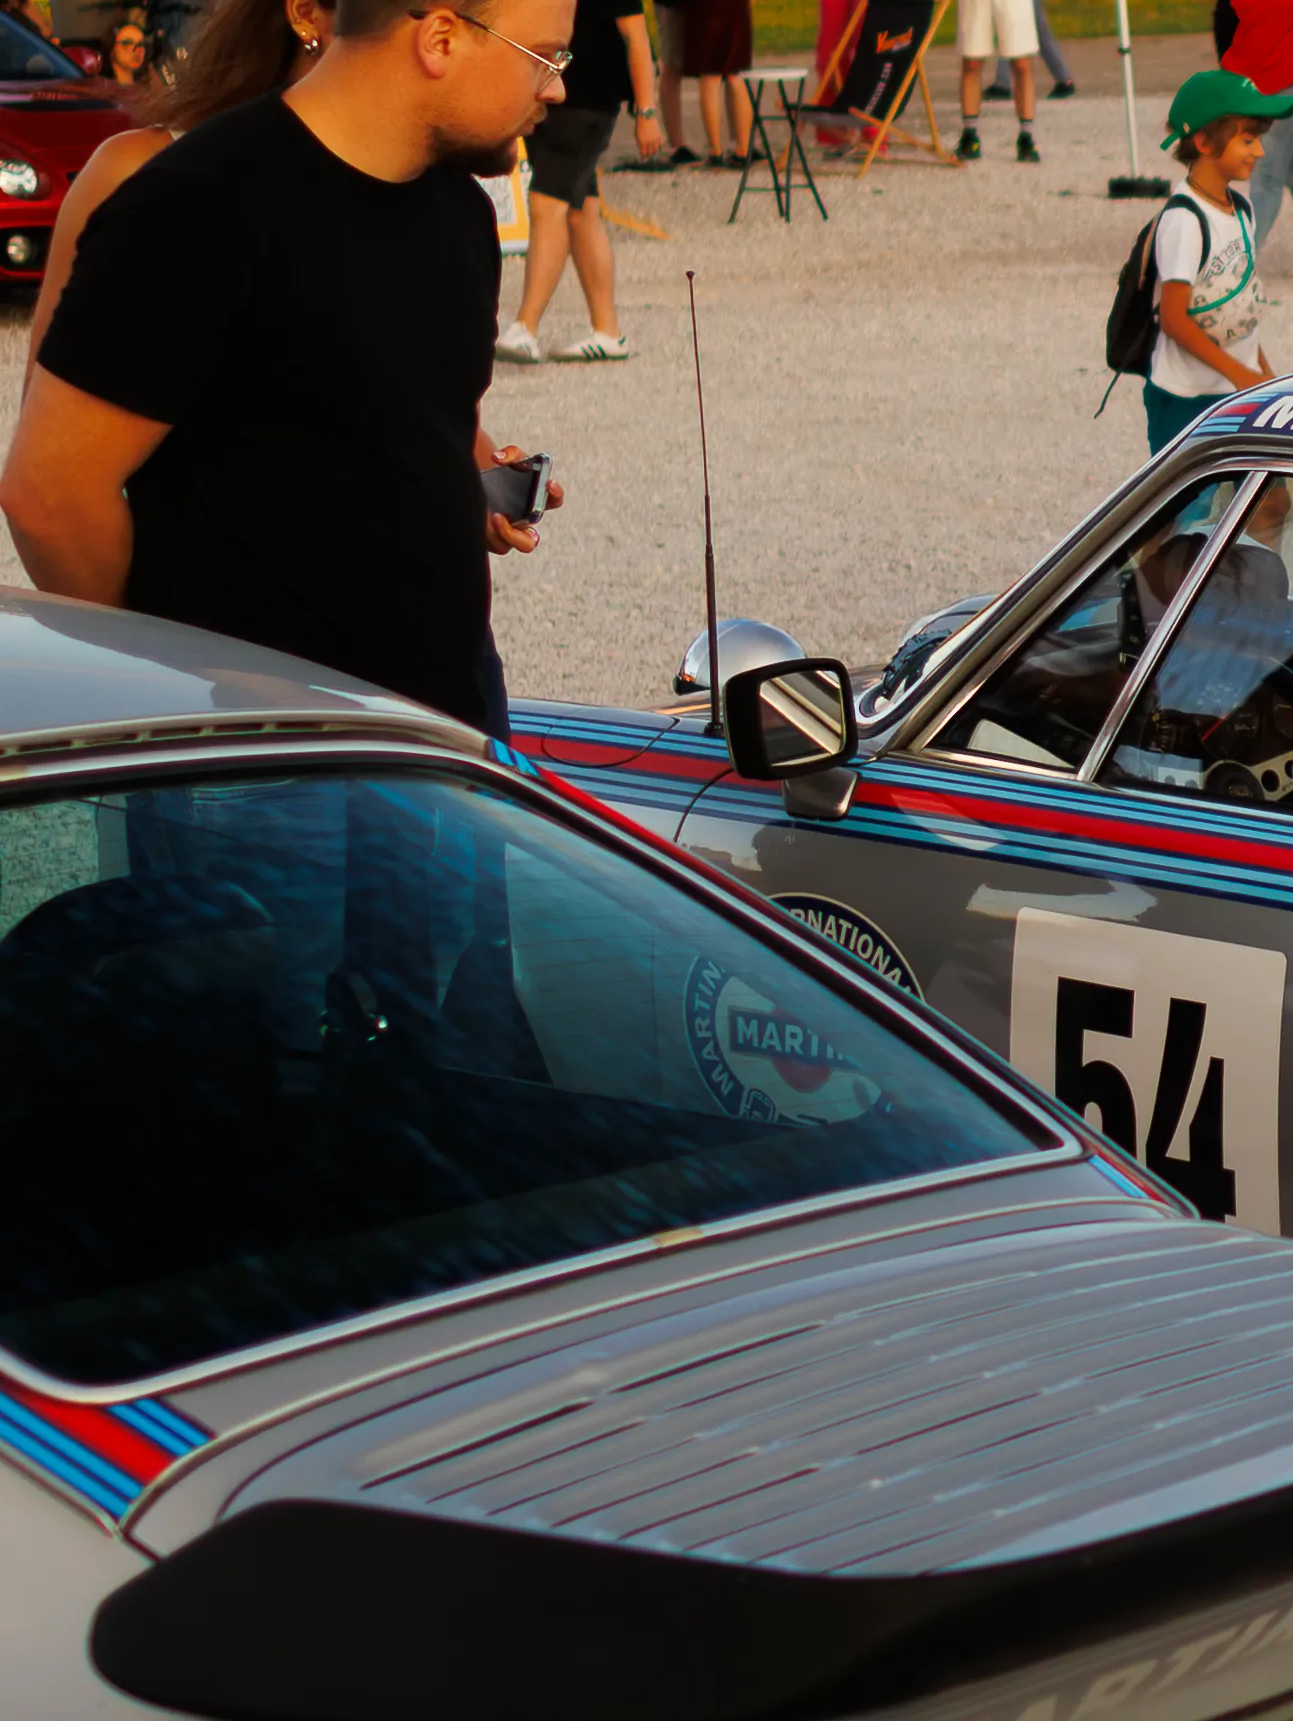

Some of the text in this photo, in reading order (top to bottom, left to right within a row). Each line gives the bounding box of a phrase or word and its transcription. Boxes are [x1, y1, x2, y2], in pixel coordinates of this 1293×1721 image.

[789, 908, 912, 994] NATIONA
[694, 960, 734, 1098] MARTIN
[736, 1015, 846, 1062] MART
[1054, 975, 1238, 1224] 54
